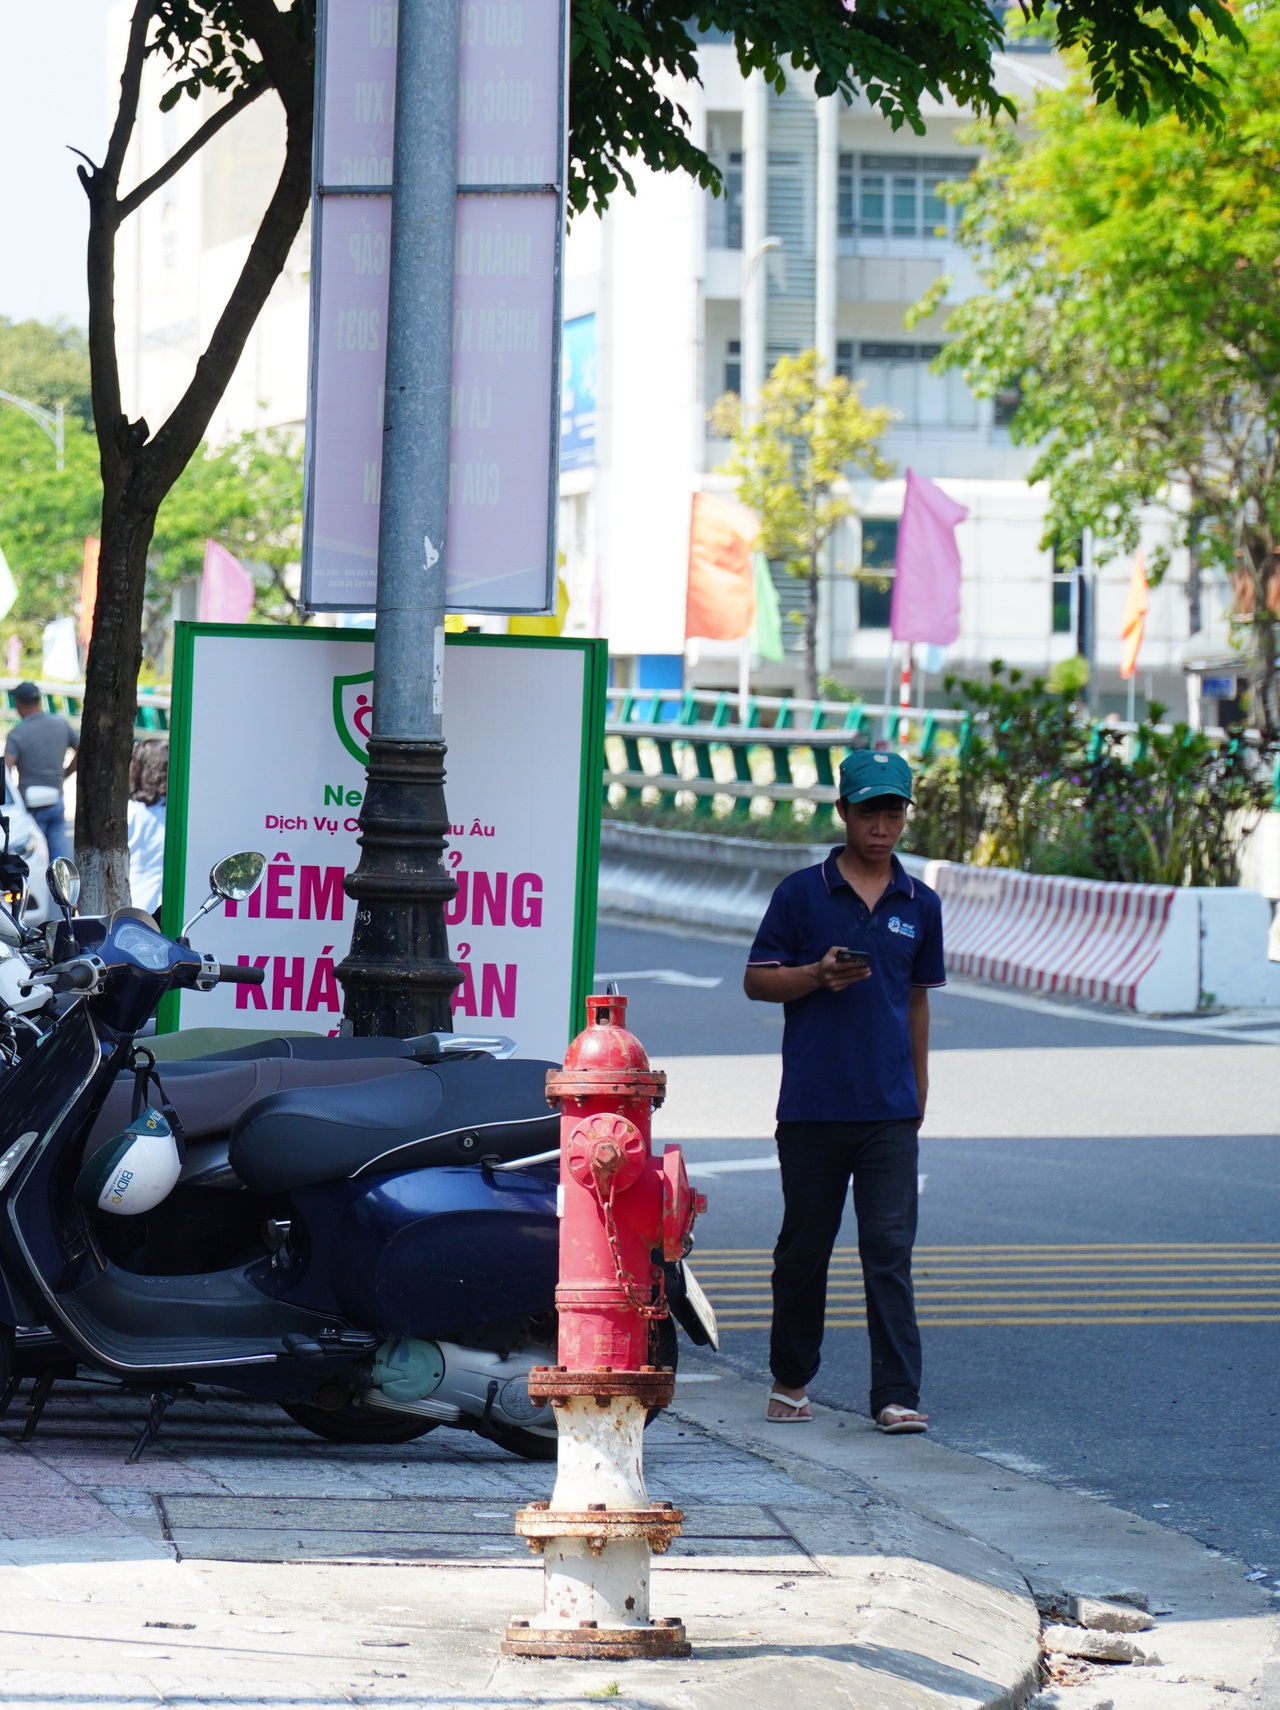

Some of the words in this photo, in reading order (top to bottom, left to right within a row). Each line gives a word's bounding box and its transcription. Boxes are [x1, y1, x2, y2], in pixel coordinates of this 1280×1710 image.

[265, 814, 308, 832] Dịch
[313, 816, 339, 836] Vụ
[469, 817, 496, 837] Âu
[444, 851, 544, 928] ỦNG
[235, 944, 342, 1013] KHÁ
[451, 942, 518, 1018] ẢN
[114, 1169, 134, 1198] BIDV
